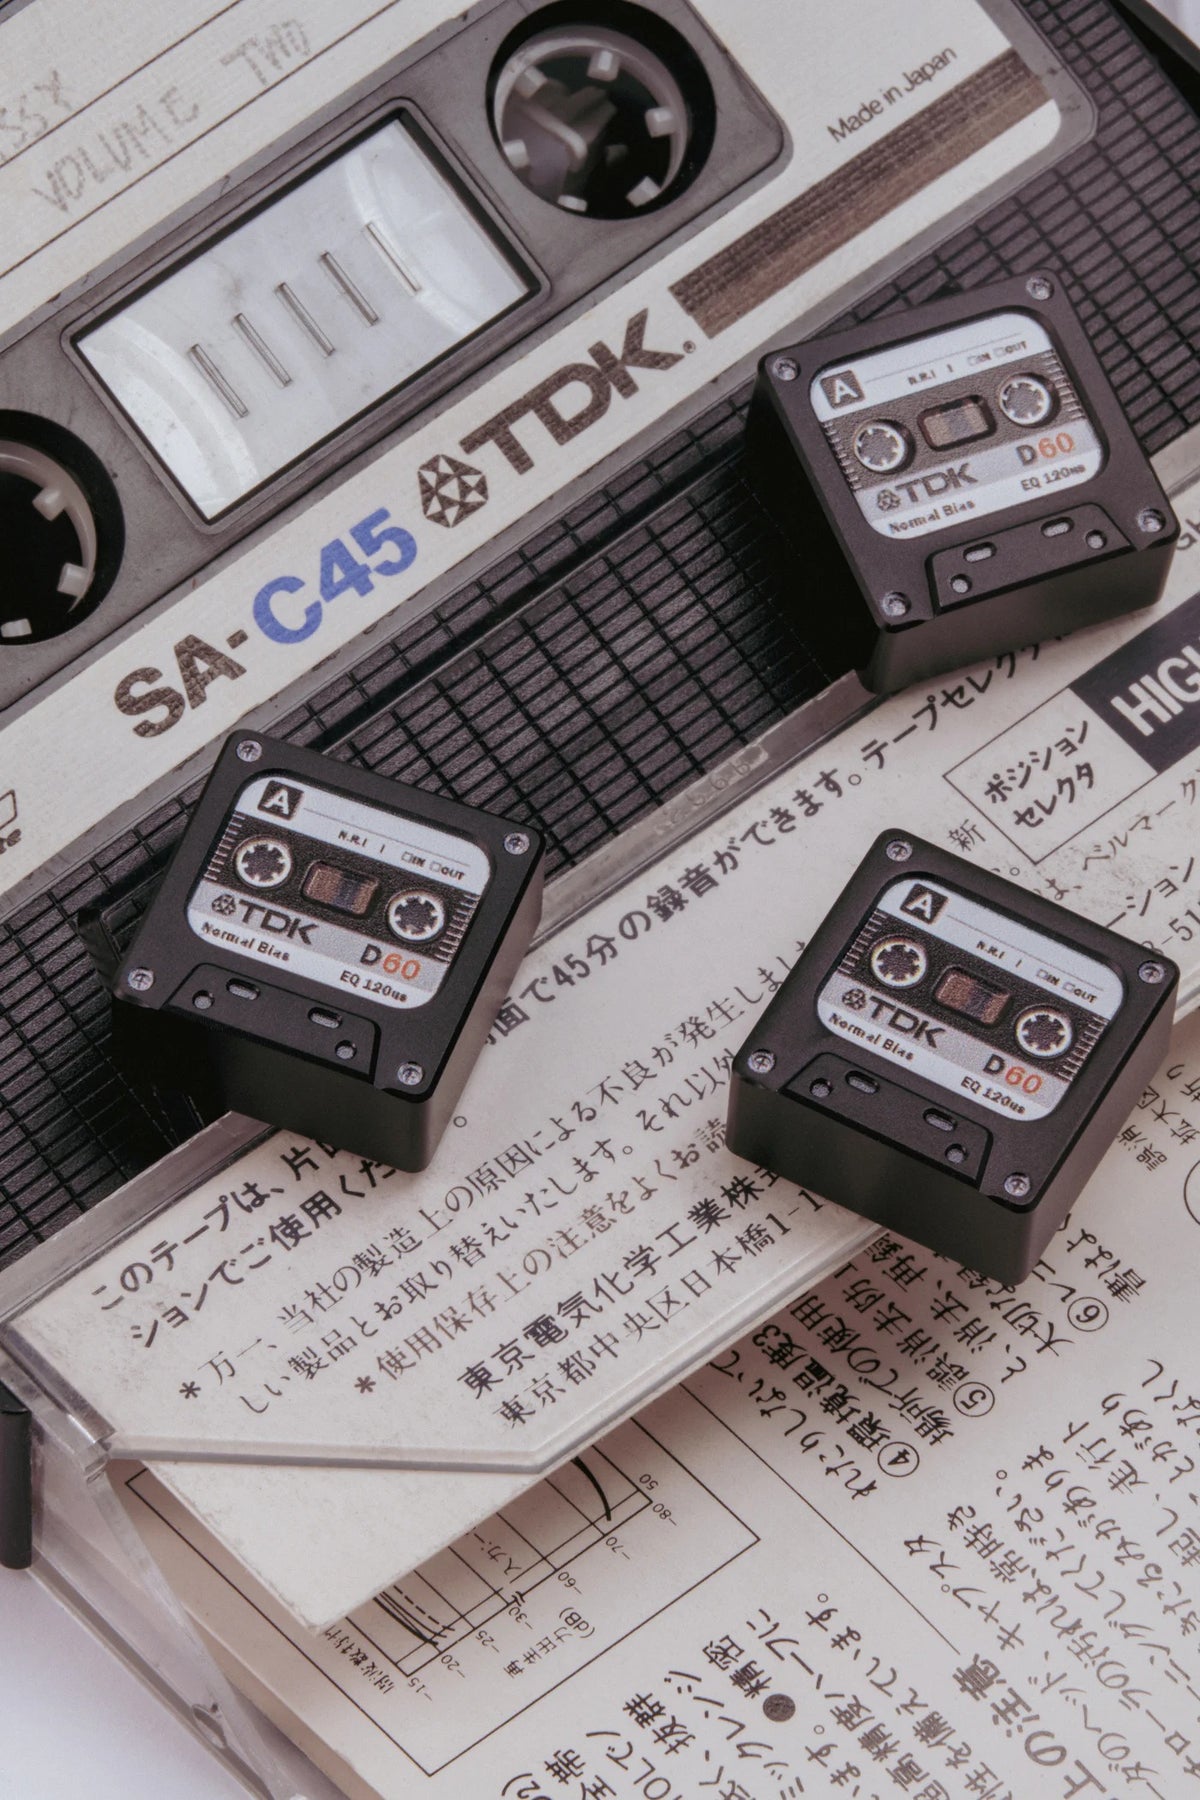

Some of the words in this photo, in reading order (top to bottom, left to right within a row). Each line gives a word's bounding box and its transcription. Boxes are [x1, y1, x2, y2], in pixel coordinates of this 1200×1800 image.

[31, 85, 200, 213] VOLUME
[219, 18, 311, 86] TWO
[826, 99, 884, 143] Made
[879, 86, 904, 106] in
[902, 47, 957, 93] Japan
[459, 308, 686, 477] TDK
[830, 372, 859, 404] A
[888, 508, 941, 534] Normal
[941, 500, 976, 517] Bias
[1020, 476, 1043, 492] EQ
[895, 462, 979, 501] TDK
[983, 720, 1089, 804] ポジション
[262, 788, 290, 815] A
[1012, 761, 1095, 829] セレクタ
[485, 650, 1038, 1046] 面で45分の録音ができます。テープセレク
[948, 818, 986, 852] 新
[237, 898, 320, 946] TDK
[905, 891, 933, 920] A
[201, 921, 256, 949] Normal
[256, 940, 290, 962] Bias
[339, 969, 361, 988] EQ
[867, 995, 947, 1049] TDK
[828, 1012, 882, 1045] Normal
[881, 1038, 914, 1061] Bias
[960, 1075, 982, 1095] EQ
[207, 940, 810, 1385] 万一、当社の製造上の原因による不良が発生しまし
[376, 1117, 728, 1381] 使用保存上の注意をよくお読
[638, 1473, 659, 1491] 50
[652, 1503, 677, 1526] -80
[602, 1536, 630, 1560] -70
[557, 1571, 582, 1594] -60
[475, 1630, 500, 1653] -25
[508, 1606, 533, 1630] -30
[558, 1607, 596, 1639] (dB)
[440, 1654, 465, 1678] -20
[503, 1626, 572, 1678] 再生出力
[701, 1634, 773, 1700] 精密
[407, 1677, 432, 1700] -15
[804, 1592, 1013, 1800] 性を備えています。
[663, 1670, 805, 1800] ミックレンジ
[952, 1653, 1107, 1800] 上の注意
[543, 1748, 617, 1800] 全帯
[585, 1730, 683, 1800] OLでノ
